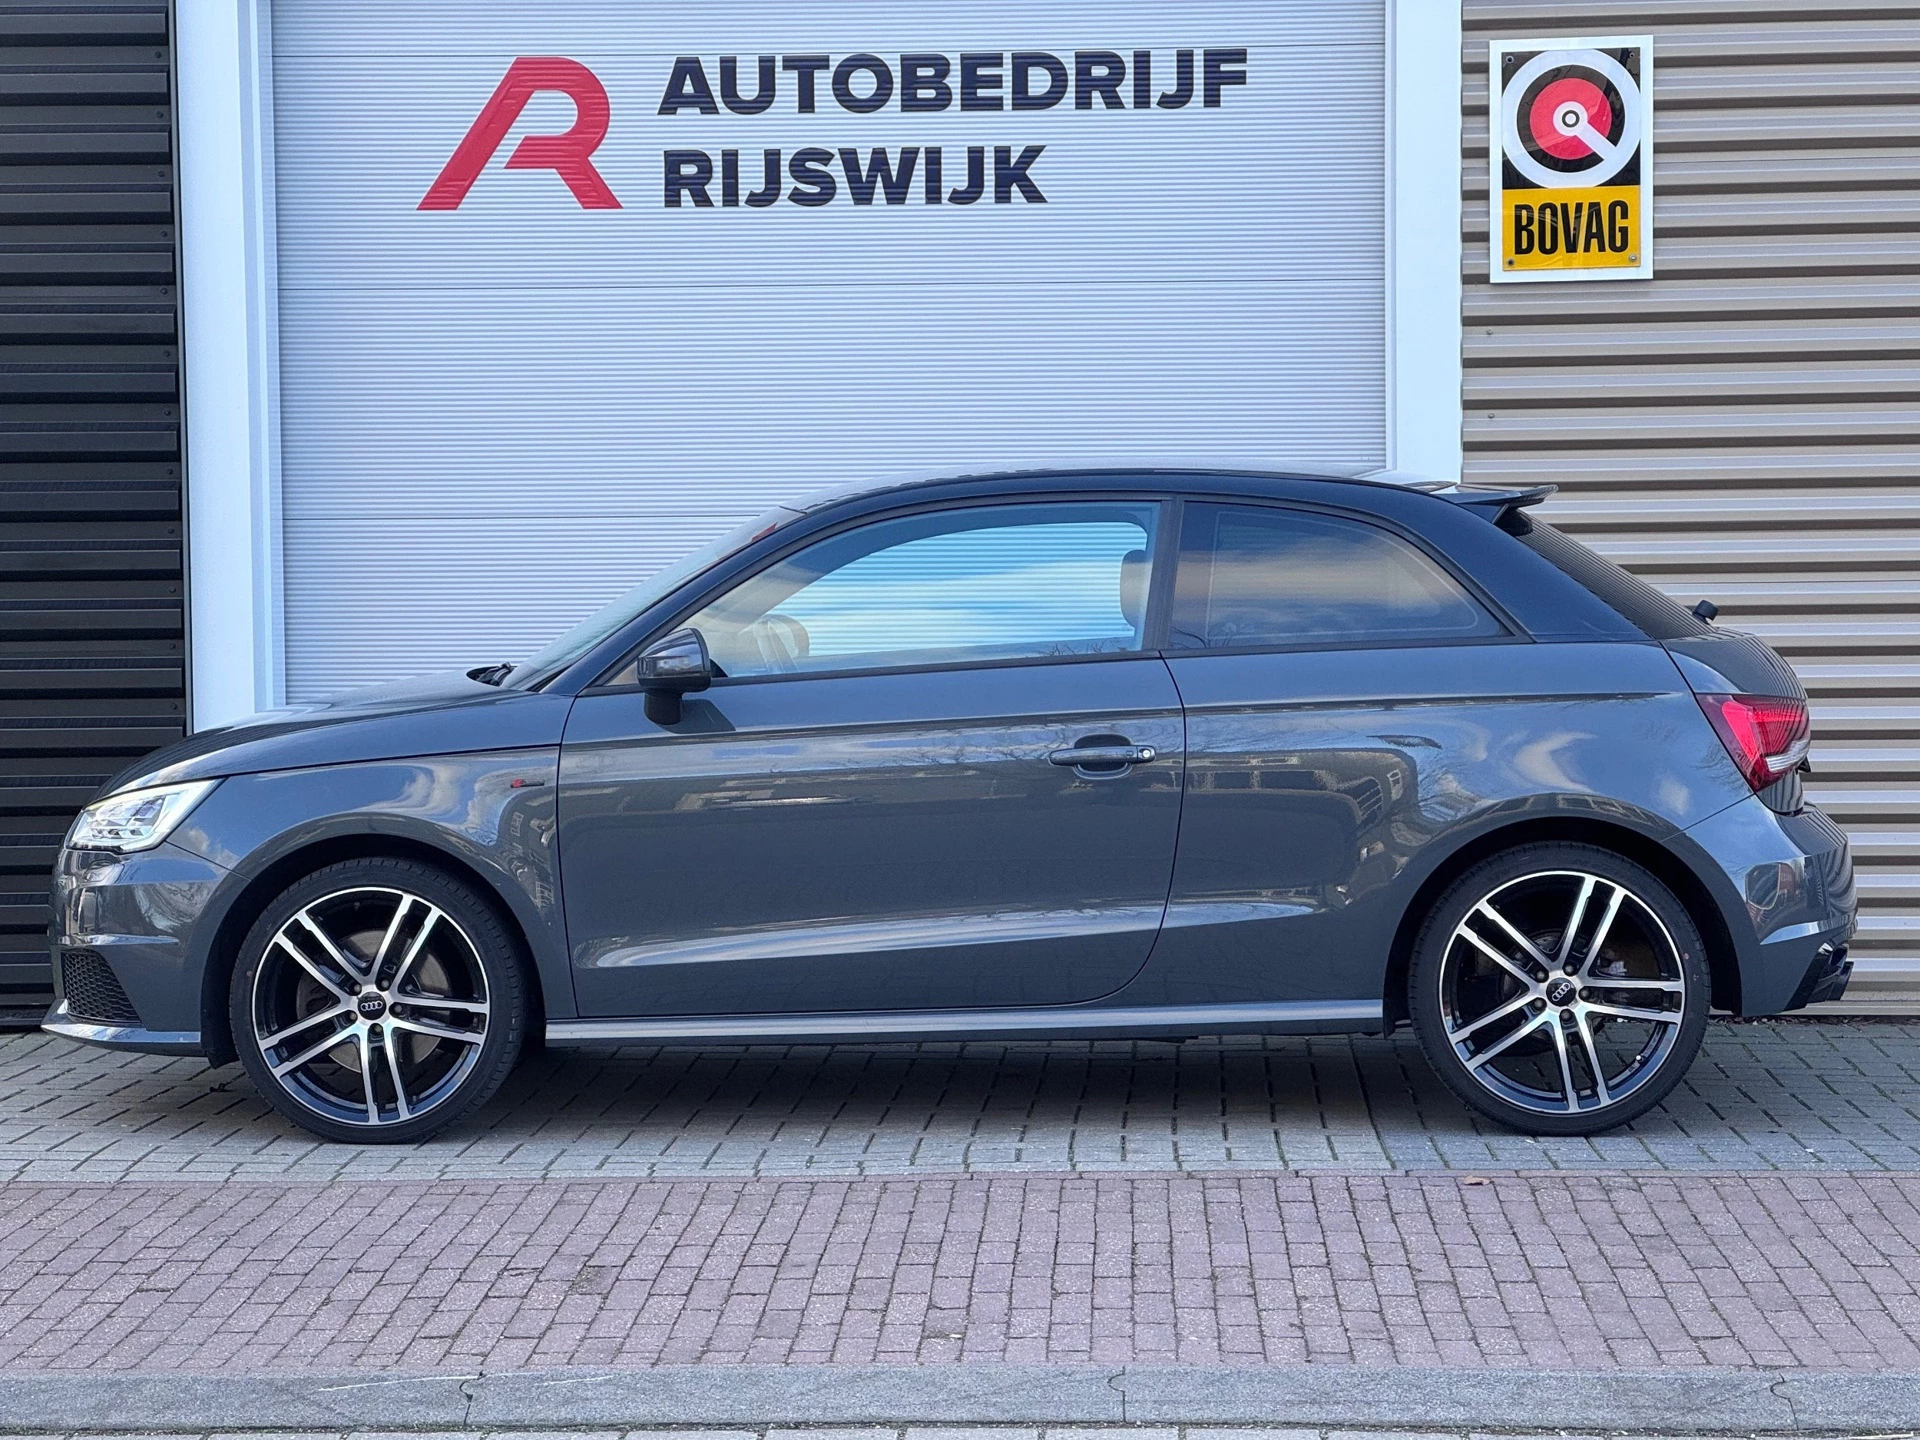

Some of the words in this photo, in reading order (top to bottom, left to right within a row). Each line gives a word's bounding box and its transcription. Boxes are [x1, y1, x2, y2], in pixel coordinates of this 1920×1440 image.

[657, 48, 1248, 116] AUTOBEDRIJF
[663, 144, 1048, 208] RIJSWIJK
[1513, 200, 1630, 255] BOVAG
